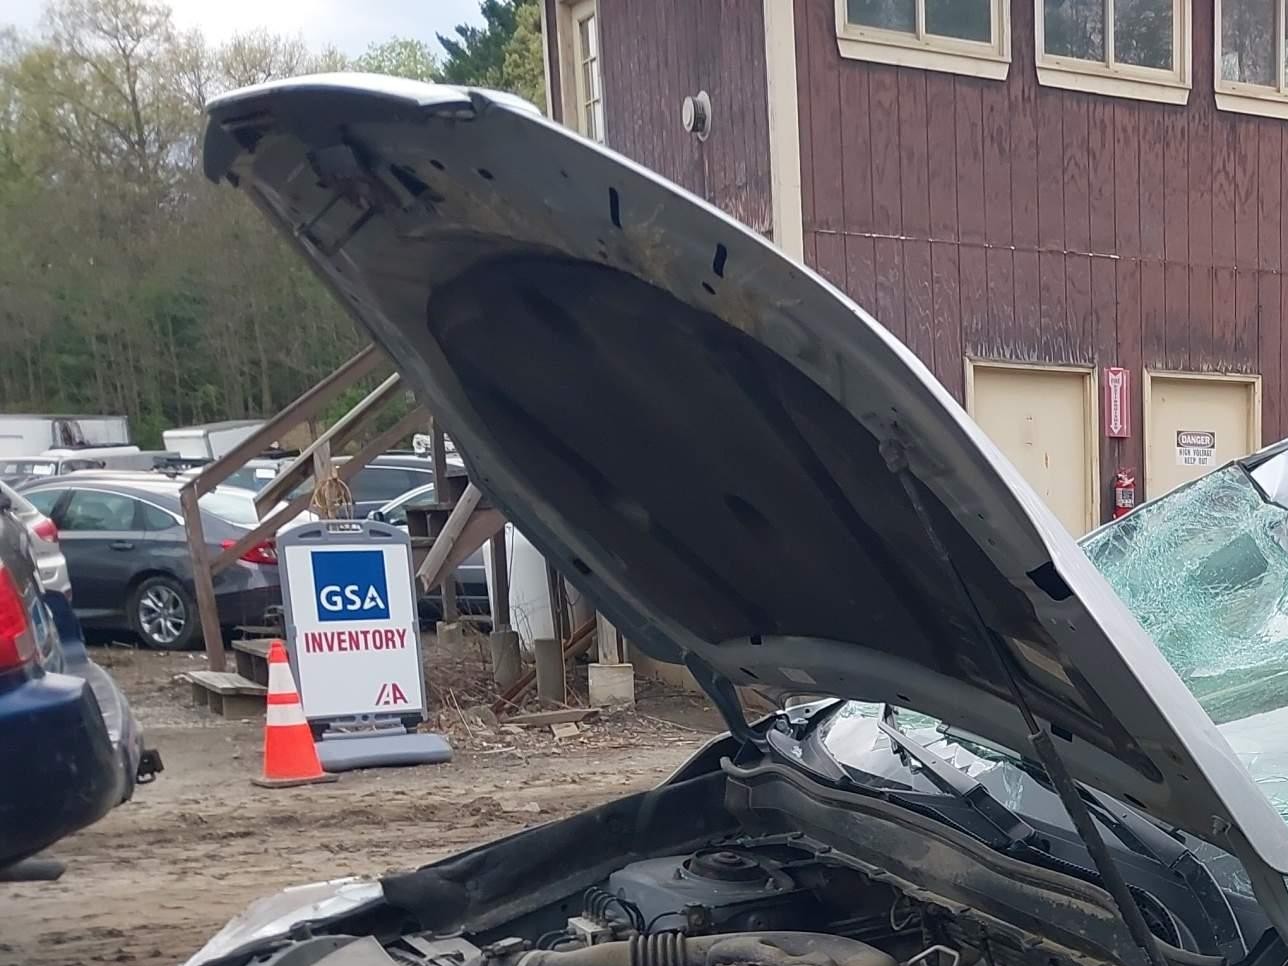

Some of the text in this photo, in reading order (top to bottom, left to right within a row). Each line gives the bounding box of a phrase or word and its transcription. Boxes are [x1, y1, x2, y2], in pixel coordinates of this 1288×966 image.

[1181, 435, 1211, 445] DANGER
[319, 584, 386, 612] GSA
[304, 628, 407, 653] INVENTORY
